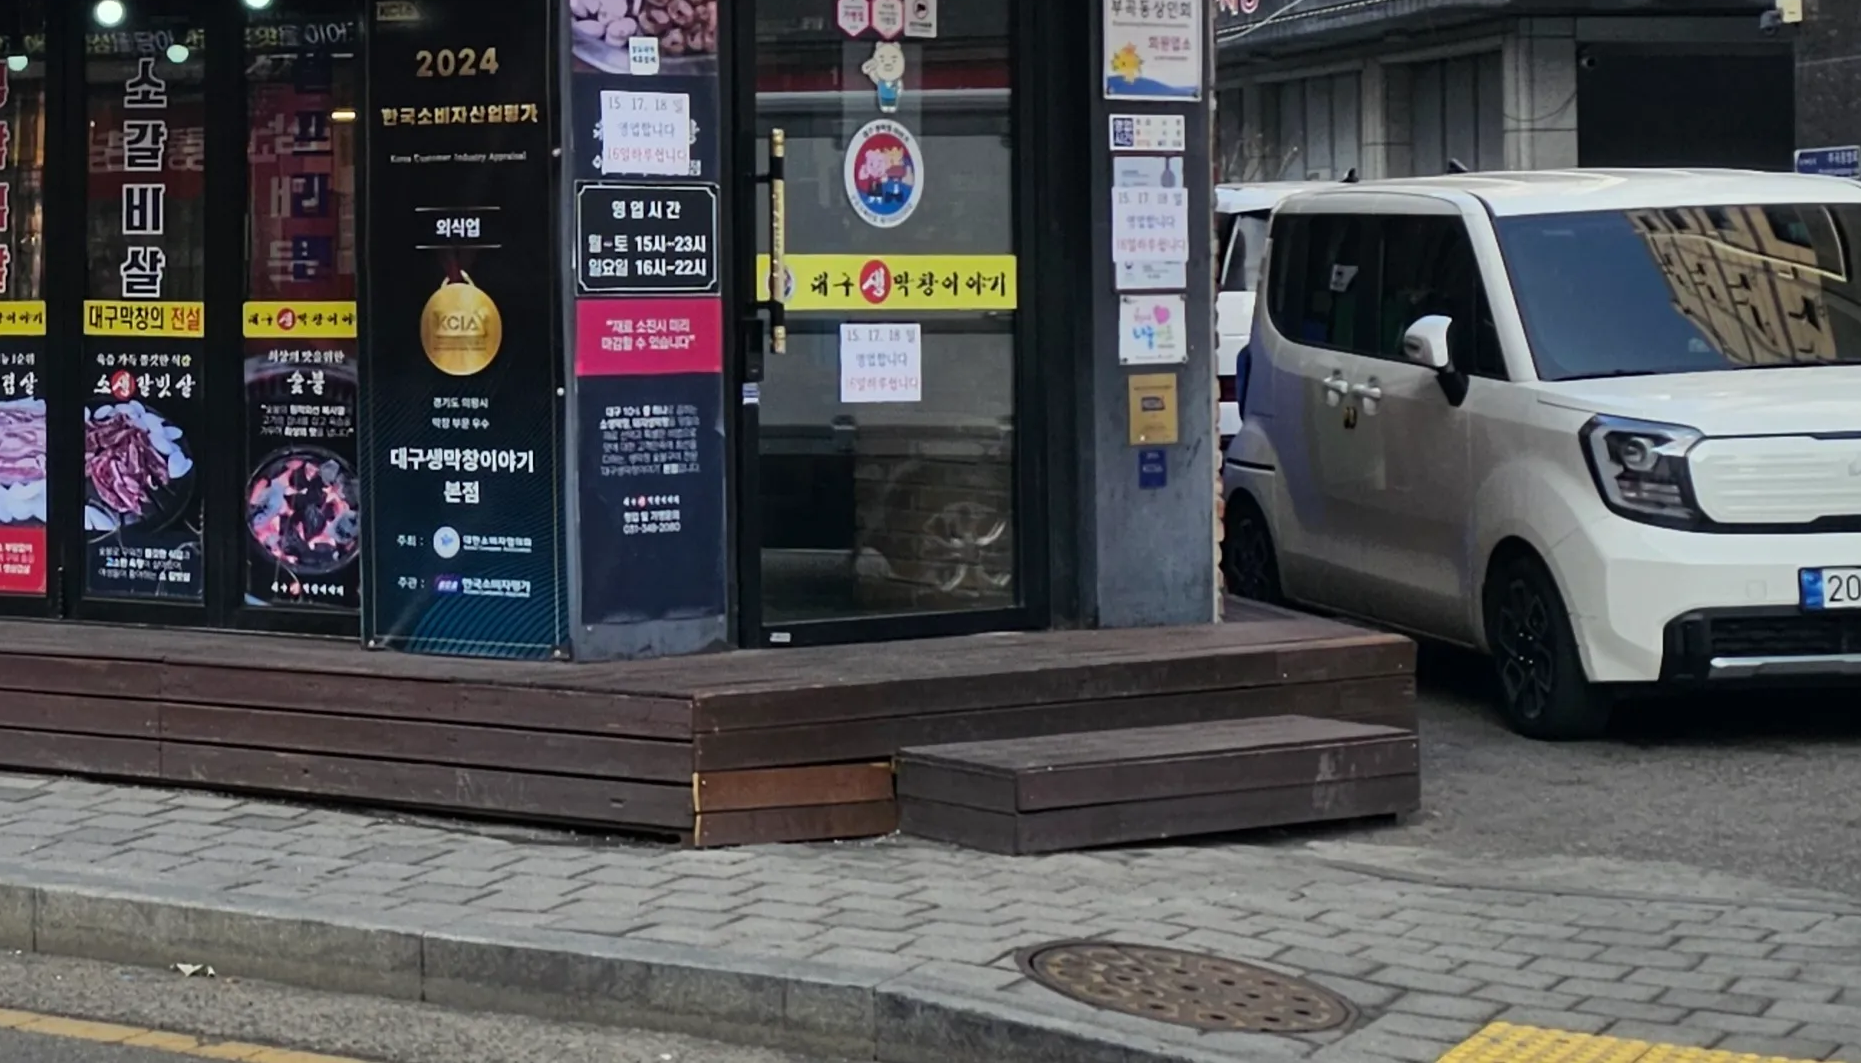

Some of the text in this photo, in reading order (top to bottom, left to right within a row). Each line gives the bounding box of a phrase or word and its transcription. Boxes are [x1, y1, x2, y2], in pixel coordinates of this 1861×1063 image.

[415, 46, 499, 78] 2024
[380, 103, 538, 127] 한국소비자산업평가
[119, 57, 168, 298] 소갈비살
[611, 200, 682, 220] 영업시간
[435, 217, 481, 238] 외식업
[588, 258, 629, 278] 일요일
[810, 264, 1007, 299] 대구생막창이야기
[88, 305, 201, 331] 대구막창의 전설
[247, 310, 356, 328] 대구생막창이야
[93, 371, 197, 399] 소생갈빗살
[286, 369, 326, 396] 숯불
[390, 447, 534, 474] 대구생막창이야기
[443, 480, 480, 504] 본점
